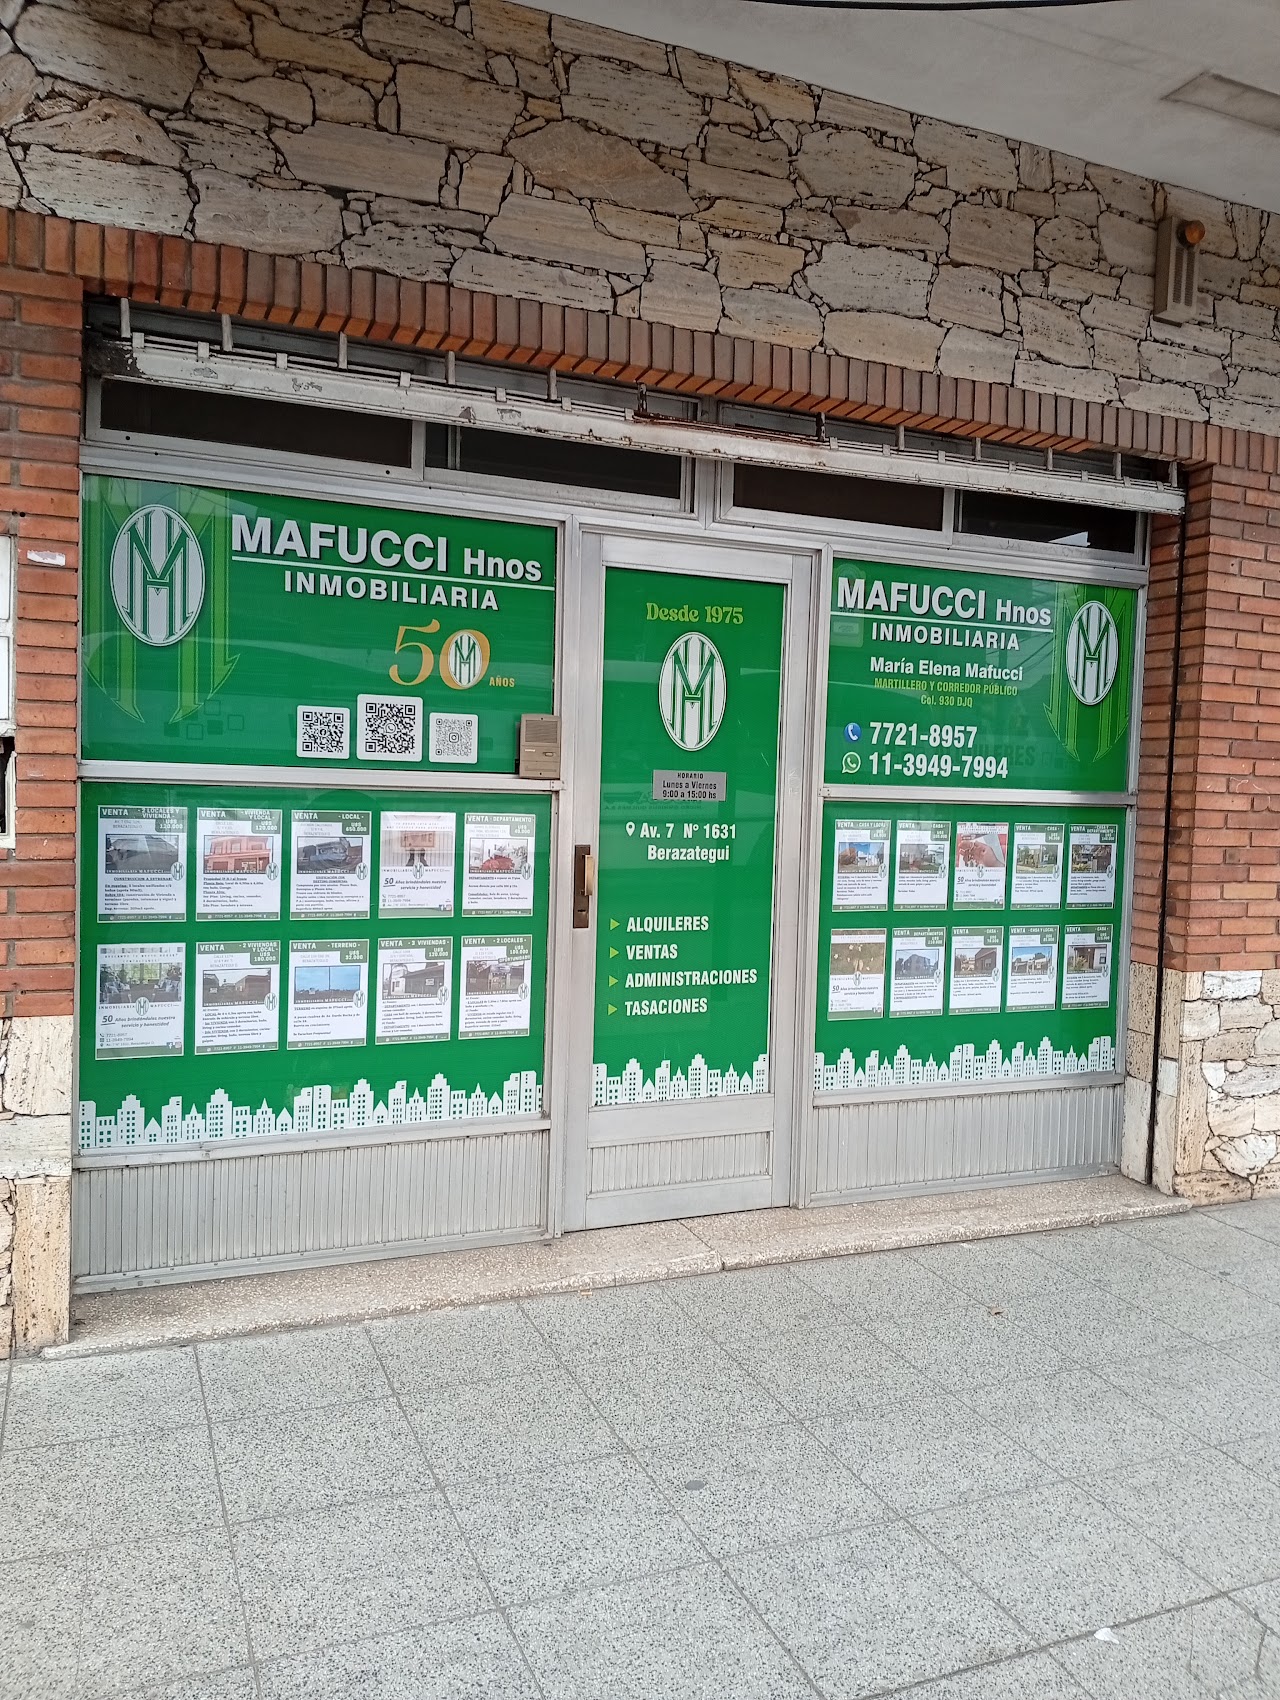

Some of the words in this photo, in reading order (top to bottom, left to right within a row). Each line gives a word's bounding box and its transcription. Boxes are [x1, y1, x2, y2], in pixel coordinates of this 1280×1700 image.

[231, 514, 449, 573] MAFUCCI
[463, 548, 543, 582] Hnos
[284, 570, 499, 611] INMOBILIARIA
[837, 576, 986, 619] MAFUCCI
[996, 599, 1052, 626] Hnos
[646, 602, 700, 622] Desde
[704, 606, 744, 625] 1975
[872, 622, 1020, 650] INMOBILIARIA
[388, 618, 491, 690] 50
[870, 656, 914, 674] María
[918, 659, 961, 677] Elena
[965, 663, 1023, 681] Mafucci
[488, 675, 516, 688] AÑOS
[874, 678, 927, 691] MARTILLERO
[929, 680, 935, 691] Y
[936, 681, 981, 694] CORREDOR
[983, 682, 1018, 696] PÚBLICO
[921, 694, 937, 706] Col.
[939, 696, 955, 706] 930
[957, 697, 973, 708] DJQ
[869, 721, 978, 749] 7721-8957
[869, 751, 1008, 779] 11-3949-7994
[662, 780, 683, 789] Lunes
[691, 781, 717, 790] Viernes
[662, 790, 679, 798] 9:00
[687, 790, 707, 799] 15:00
[708, 791, 717, 799] hs
[102, 808, 129, 816] VENTA
[201, 810, 226, 818] VENTA
[294, 812, 318, 820] VENTA
[639, 822, 661, 838] Av.
[666, 823, 675, 838] 7
[703, 824, 737, 839] 1631
[647, 845, 730, 863] Berazategui
[384, 877, 394, 885] 50
[626, 916, 709, 933] ALQUILERES
[200, 944, 225, 952] VENTA
[626, 944, 678, 960] VENTAS
[625, 969, 758, 988] ADMINISTRACIONES
[625, 997, 708, 1016] TASACIONES
[102, 1015, 113, 1023] 50
